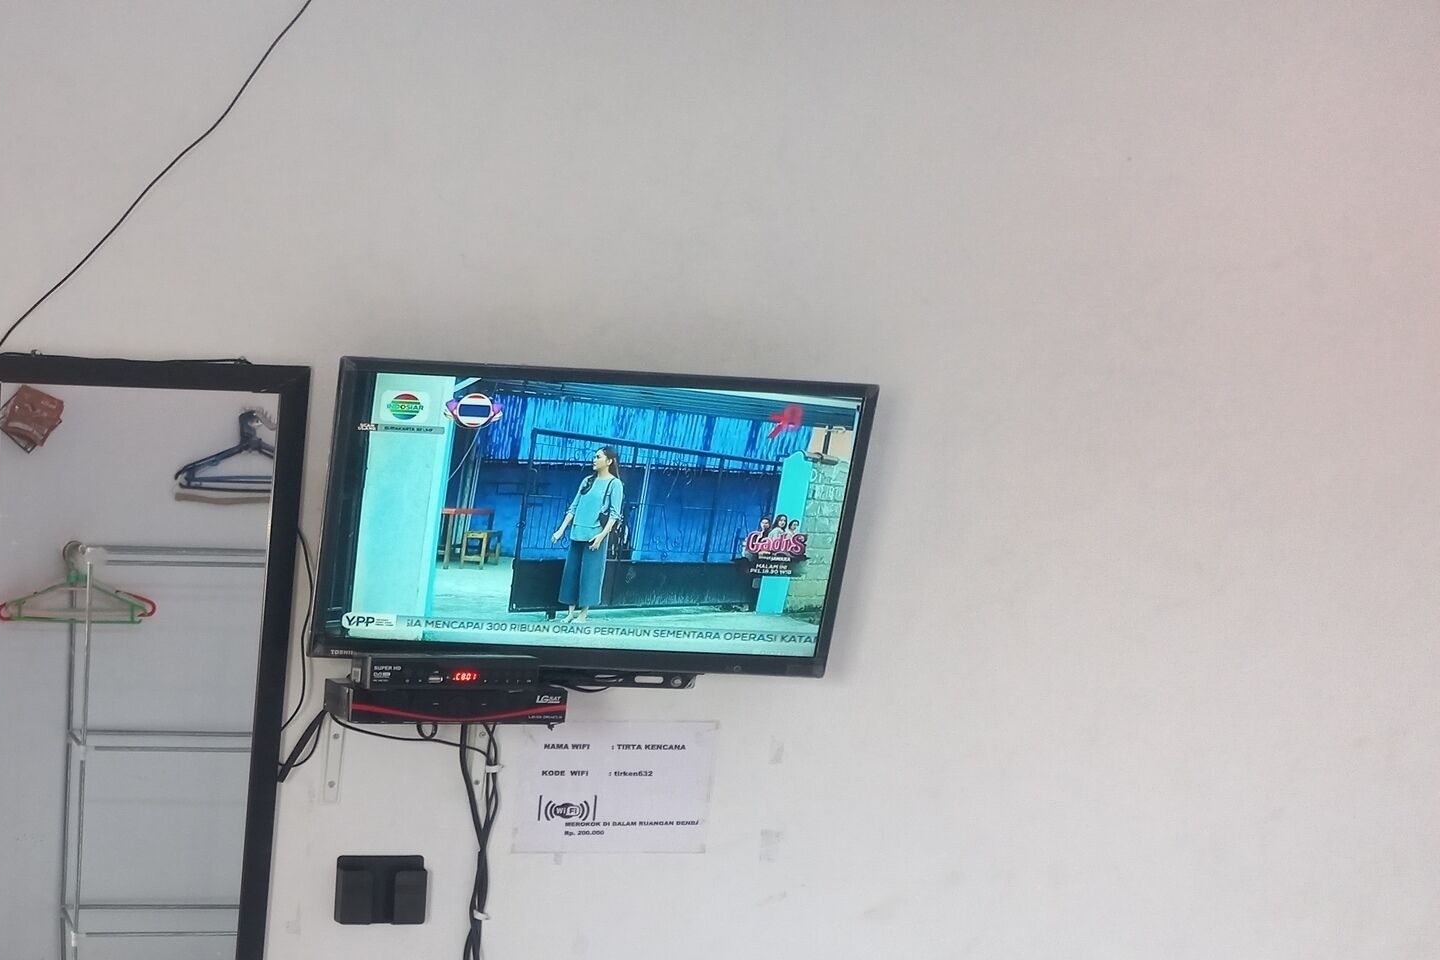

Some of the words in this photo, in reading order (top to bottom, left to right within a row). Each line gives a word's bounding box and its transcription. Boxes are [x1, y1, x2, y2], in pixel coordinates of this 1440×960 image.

[345, 615, 375, 627] YPP
[424, 619, 483, 631] MENCAPAI
[486, 622, 507, 632] 300
[509, 623, 550, 634] RIBUAN
[552, 625, 591, 635] ORANG
[593, 626, 651, 638] PERTAHUN
[652, 629, 722, 641] SEMENTARA
[723, 632, 778, 643] OPERASI
